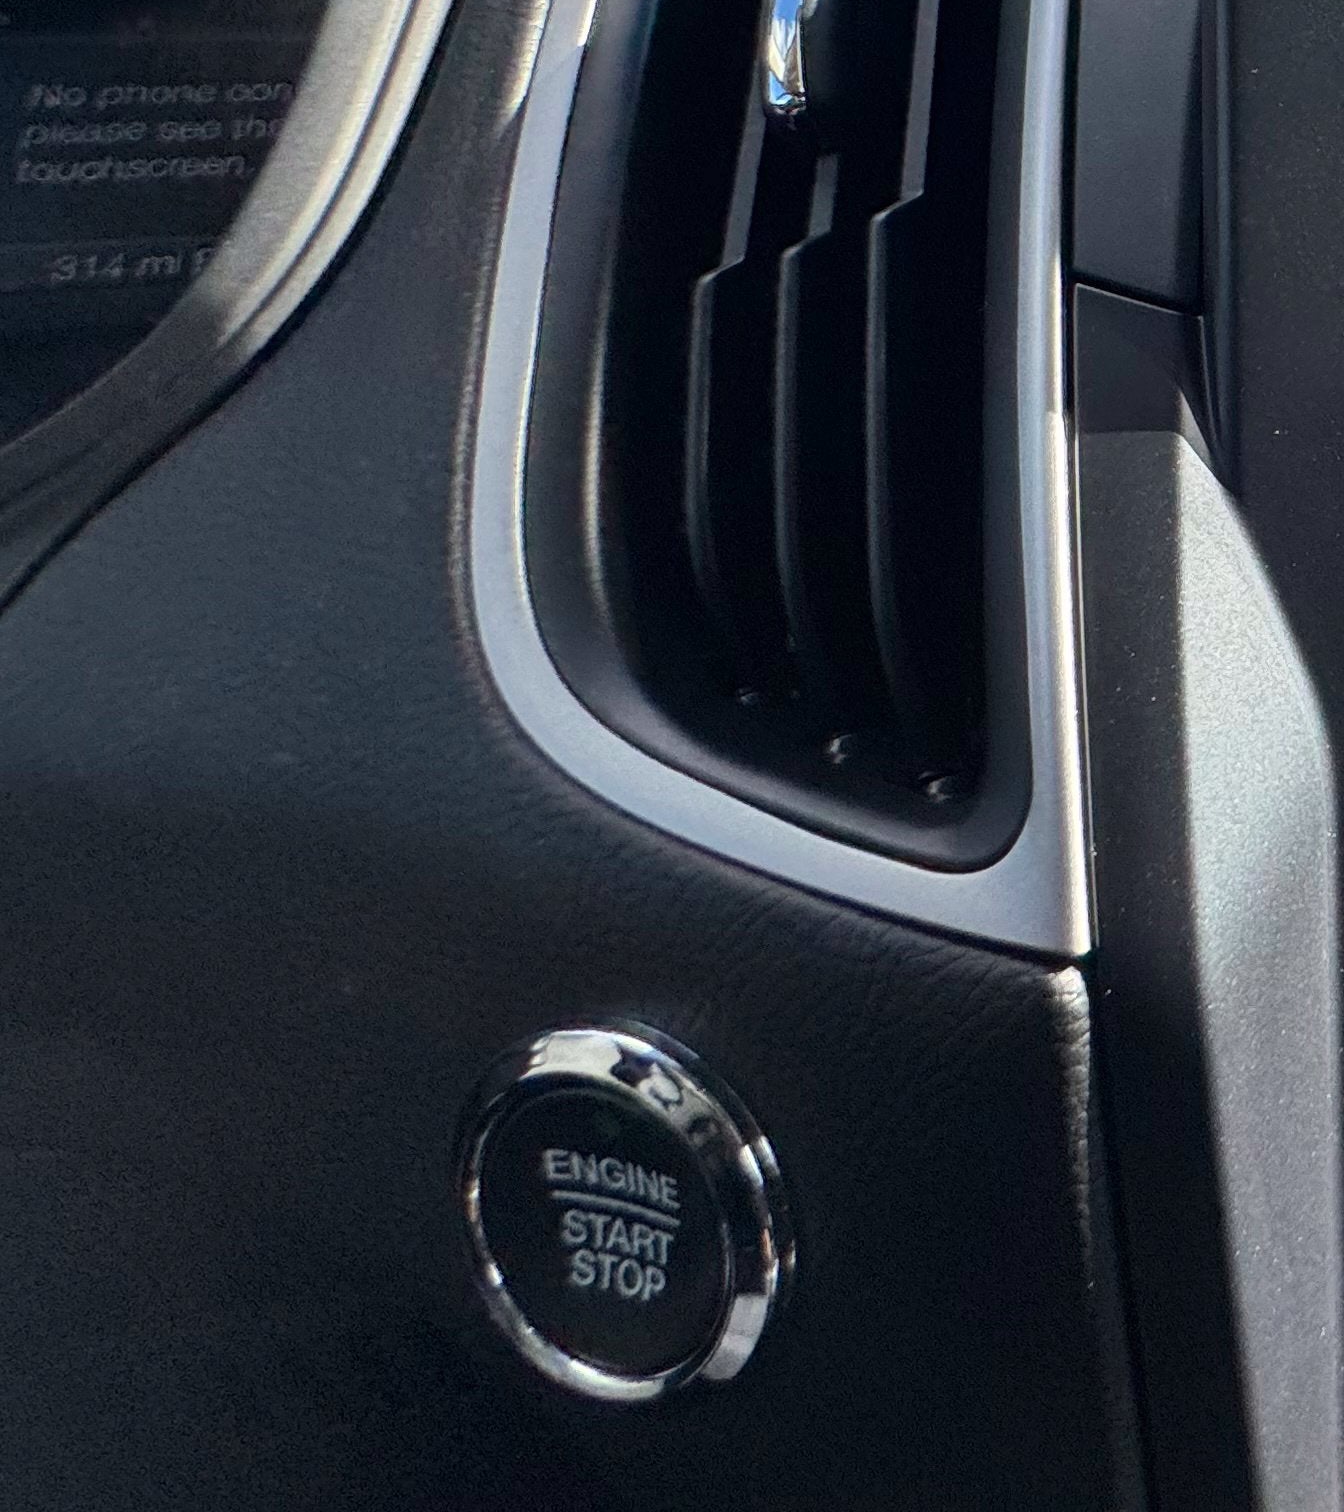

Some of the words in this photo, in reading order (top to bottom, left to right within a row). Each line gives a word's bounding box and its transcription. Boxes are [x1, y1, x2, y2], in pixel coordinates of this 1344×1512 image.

[25, 84, 88, 109] No
[97, 82, 218, 111] phone
[20, 119, 147, 148] please
[158, 120, 222, 141] see
[50, 254, 125, 283] 314
[541, 1147, 681, 1210] ENGINE
[560, 1208, 675, 1265] START
[567, 1248, 667, 1302] STOP
